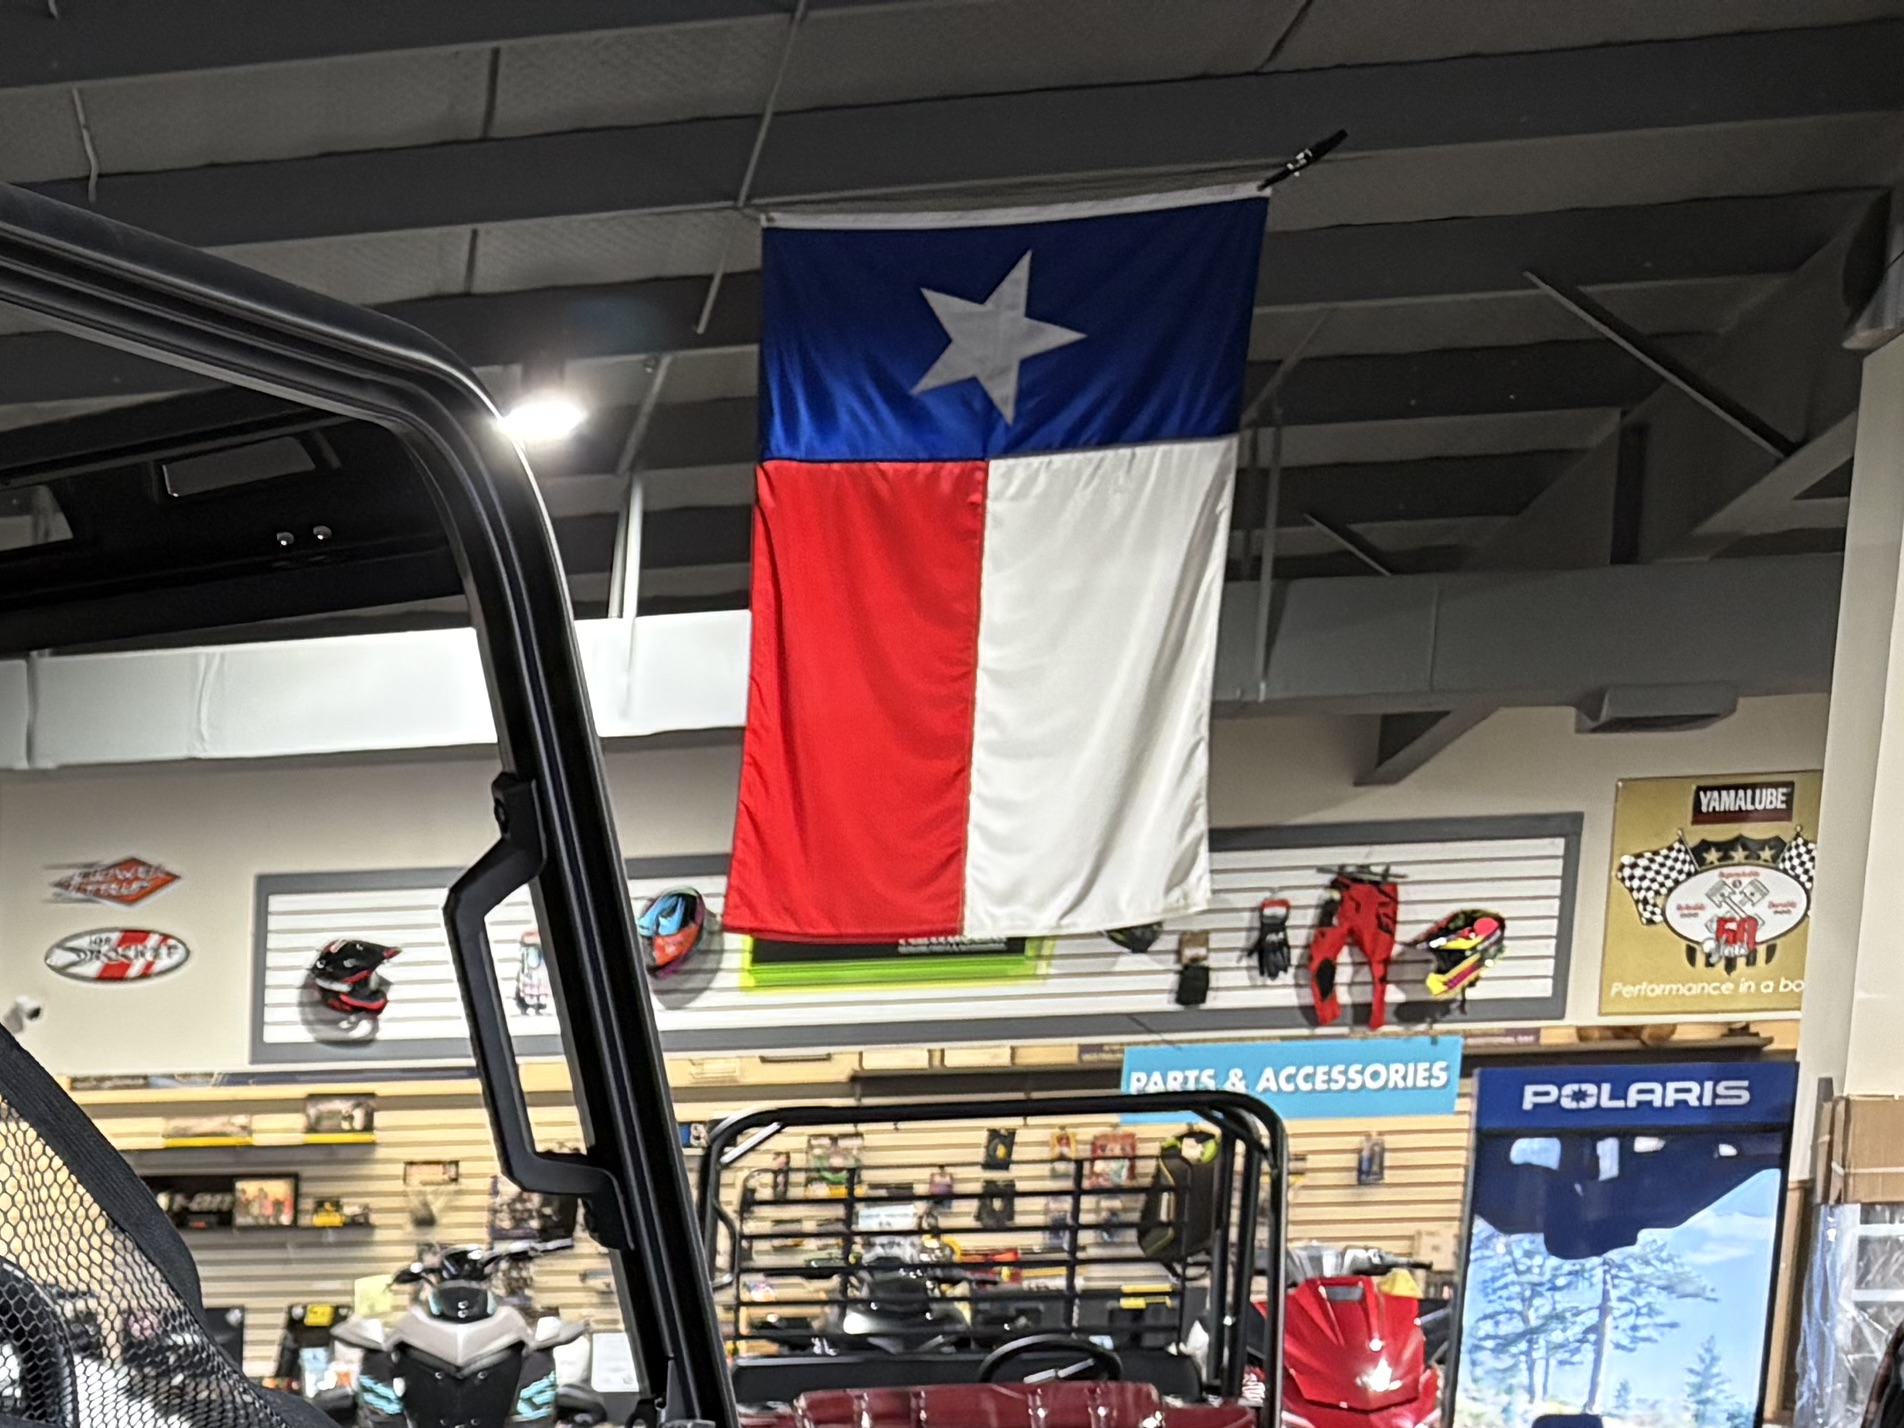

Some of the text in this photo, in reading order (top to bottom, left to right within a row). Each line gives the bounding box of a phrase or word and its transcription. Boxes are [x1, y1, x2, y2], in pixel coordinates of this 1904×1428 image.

[1699, 788, 1789, 814] YAMALUBE
[1611, 979, 1735, 998] Performance
[1739, 978, 1757, 993] in
[1759, 980, 1774, 993] a
[1129, 1060, 1449, 1094] PARTS & ACCESSORIES
[1523, 1079, 1751, 1113] POLARIS
